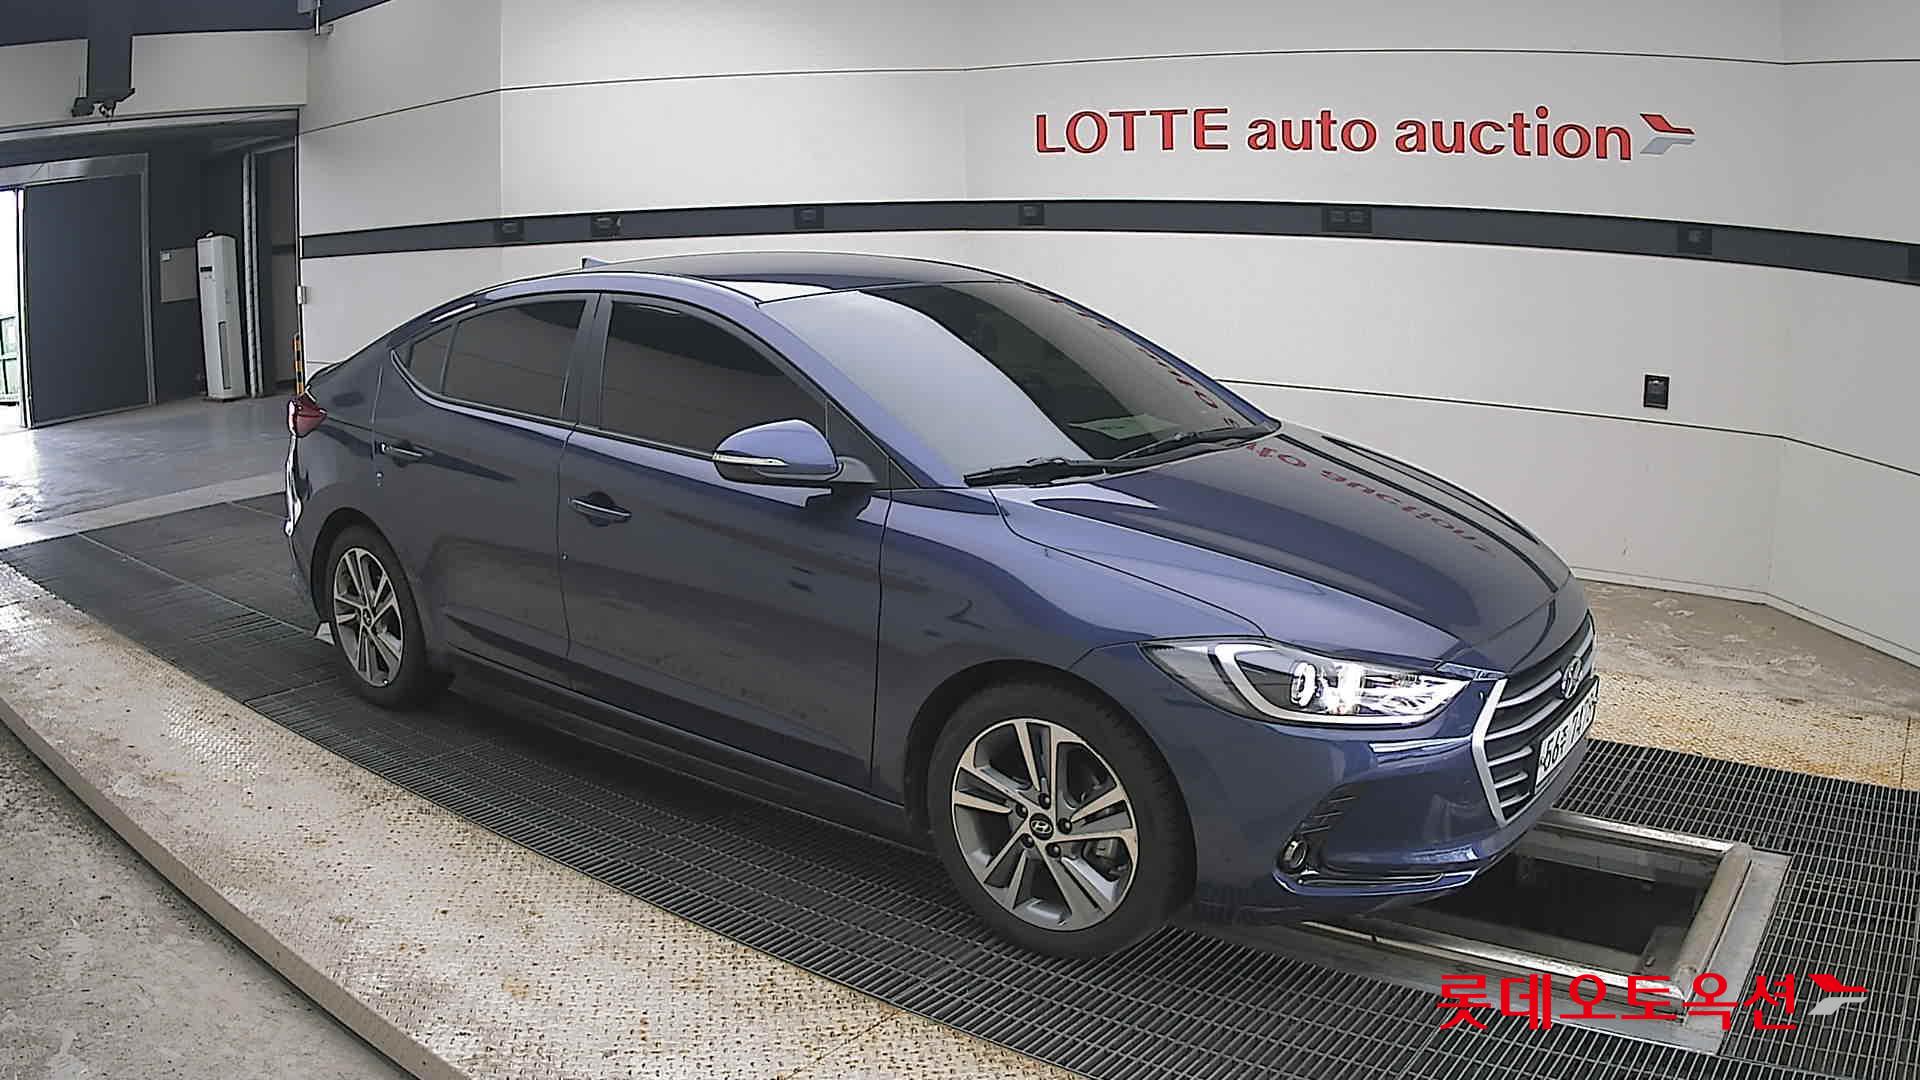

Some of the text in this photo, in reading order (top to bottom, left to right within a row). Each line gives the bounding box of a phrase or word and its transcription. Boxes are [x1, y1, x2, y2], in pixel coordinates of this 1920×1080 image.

[1036, 105, 1633, 161] LOTTE auto auction
